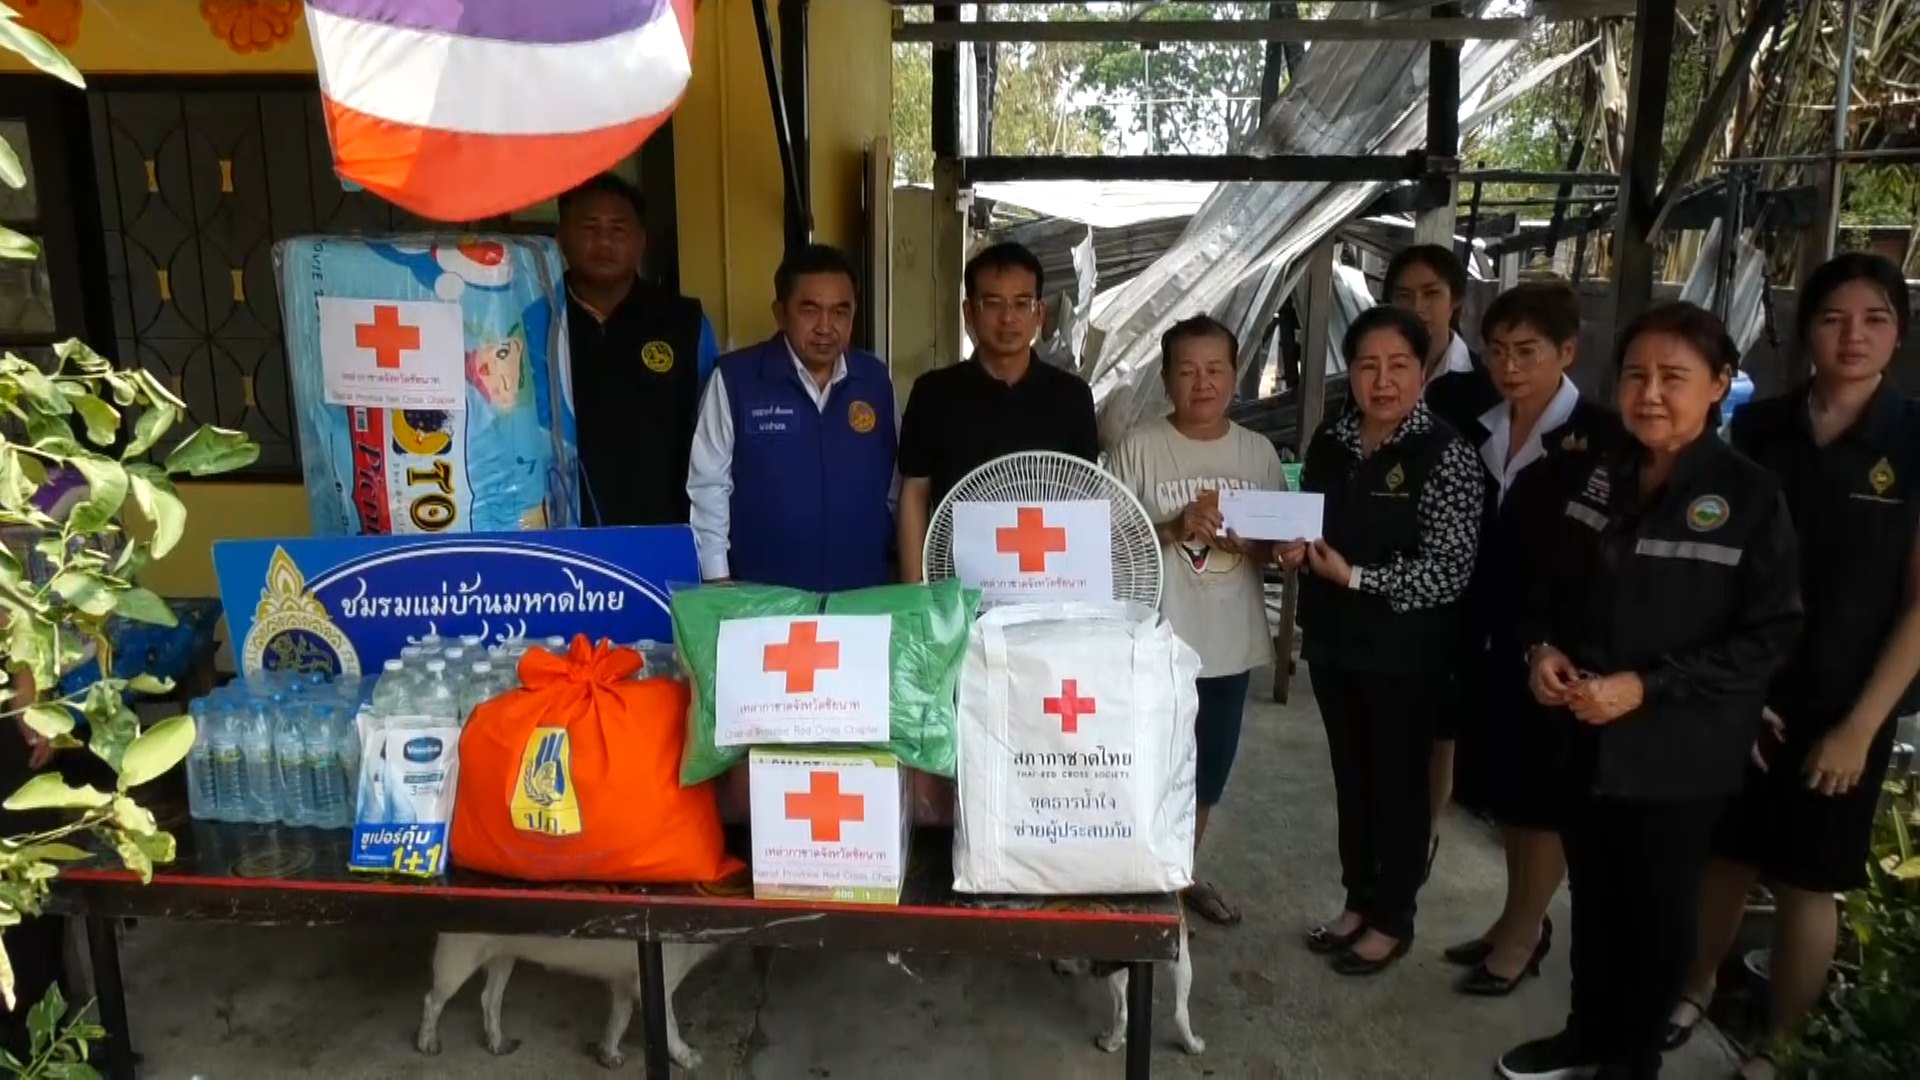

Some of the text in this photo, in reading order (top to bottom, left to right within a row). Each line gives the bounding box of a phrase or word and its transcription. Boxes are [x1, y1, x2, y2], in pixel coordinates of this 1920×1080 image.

[341, 567, 624, 618] ชมรมแม่บ้านมหาดไทย
[1014, 745, 1132, 766] สภากาชาดไทย
[1029, 788, 1116, 814] ชุดธารน้ำใจ
[361, 825, 431, 850] ซูเปอร์คุ้ม
[392, 843, 441, 874] 1+1
